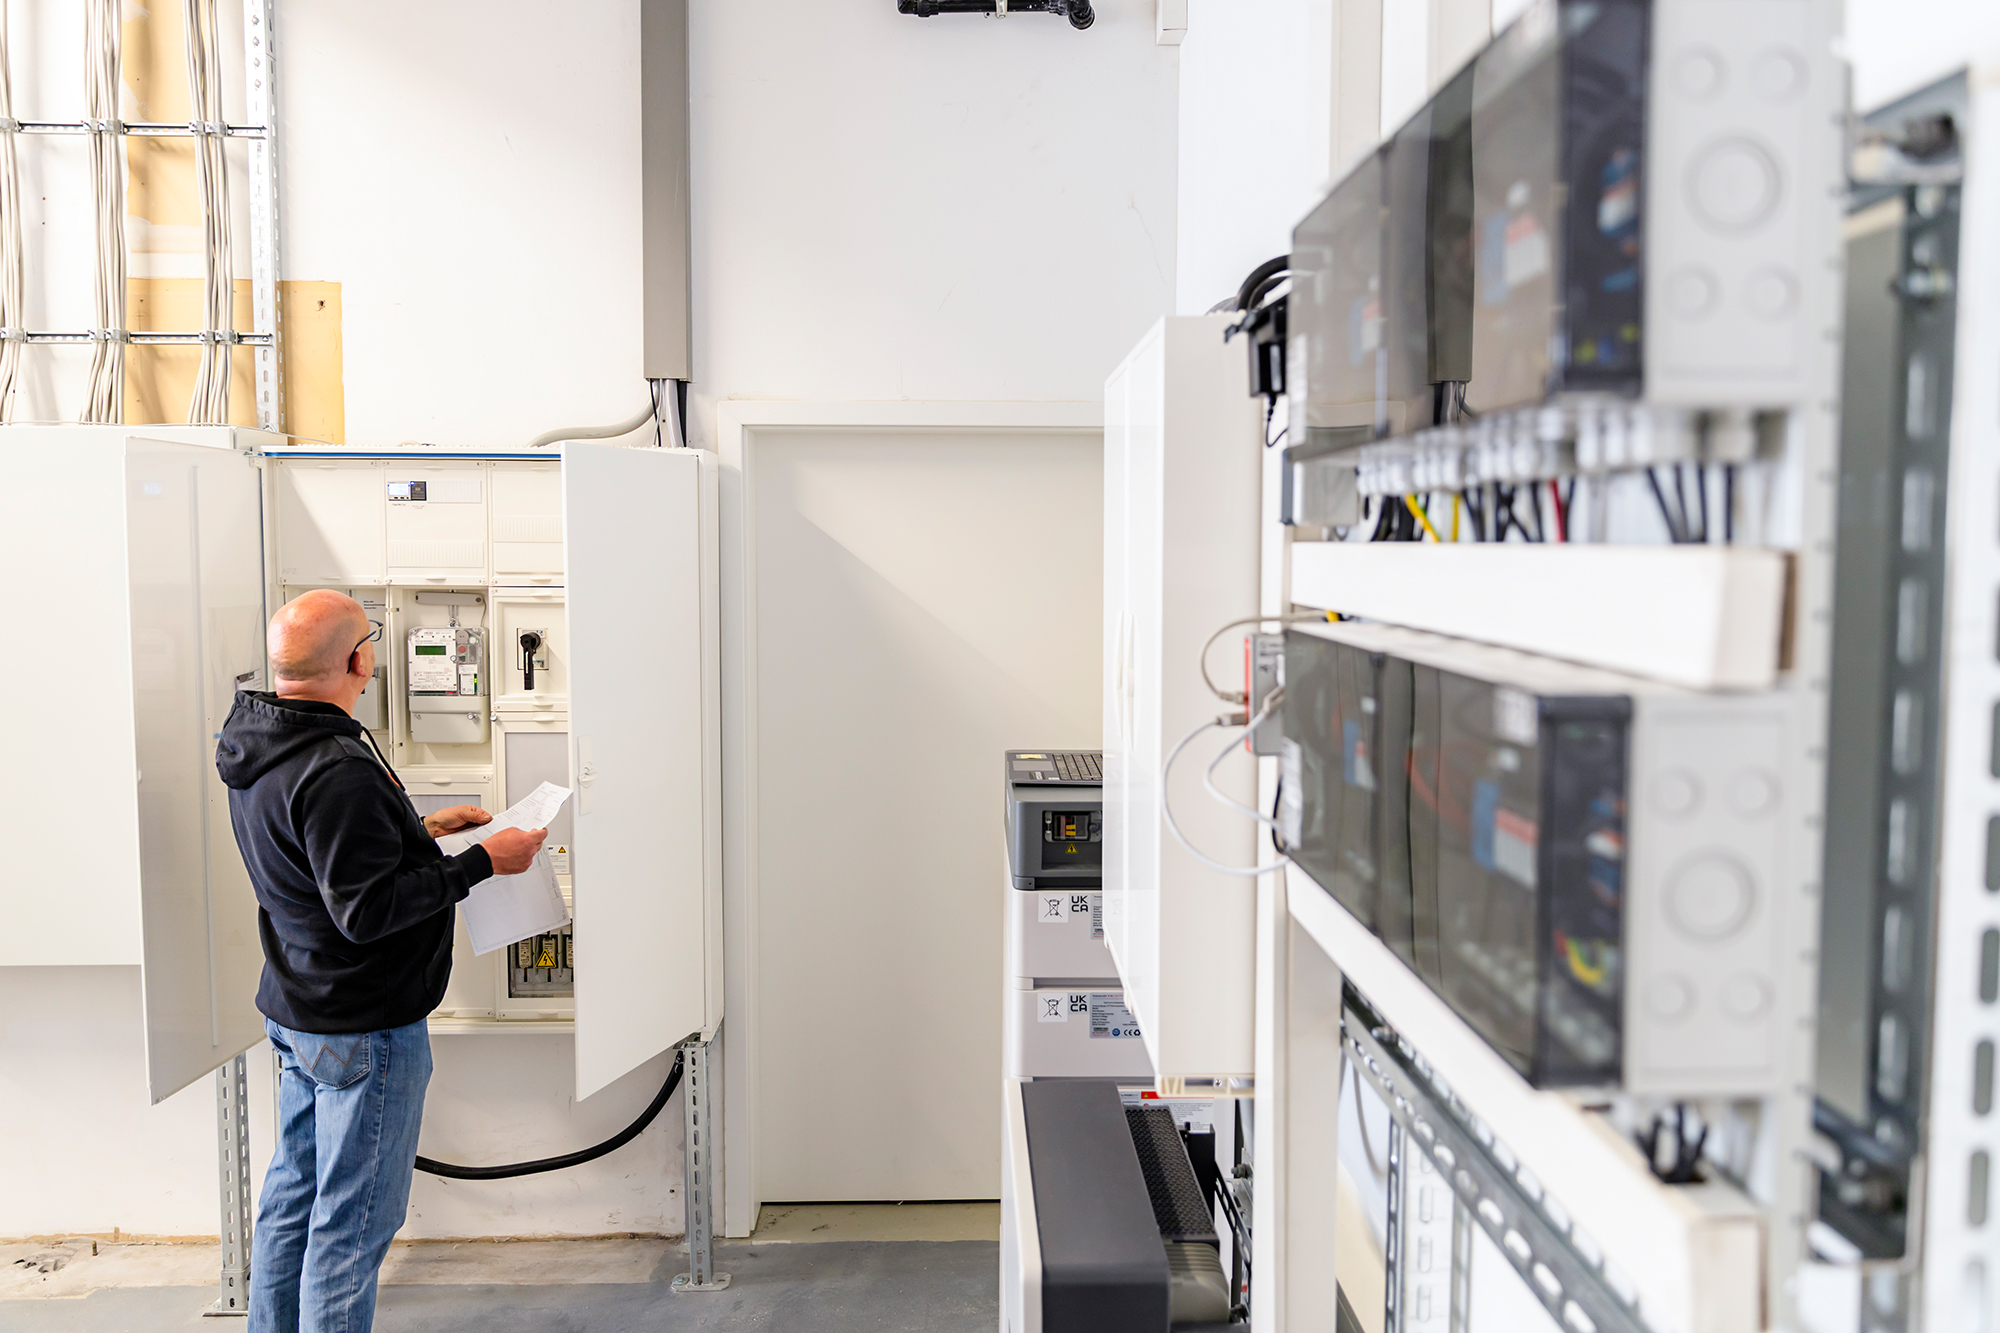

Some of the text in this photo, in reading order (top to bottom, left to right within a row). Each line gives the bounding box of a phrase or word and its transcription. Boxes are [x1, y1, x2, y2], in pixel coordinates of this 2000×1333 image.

[281, 567, 297, 575] APZ
[1071, 895, 1088, 904] UK
[1071, 904, 1089, 913] CA
[1070, 995, 1087, 1004] UK
[1070, 1003, 1088, 1012] CA
